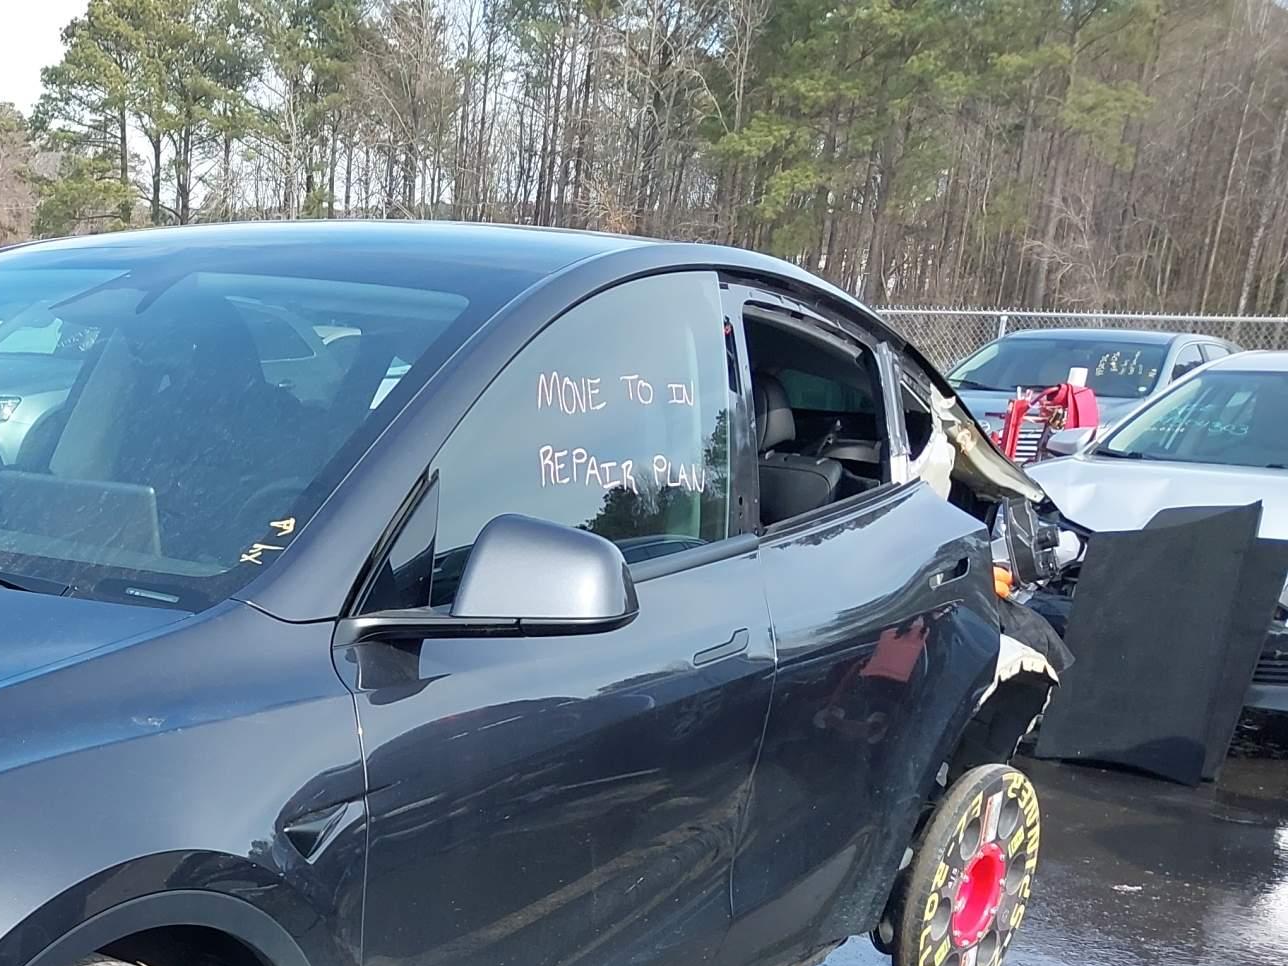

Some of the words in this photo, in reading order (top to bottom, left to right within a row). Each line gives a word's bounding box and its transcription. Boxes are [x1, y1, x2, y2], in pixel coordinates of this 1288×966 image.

[537, 371, 606, 414] MOVE
[619, 374, 653, 404] TO
[667, 379, 695, 406] IN
[538, 445, 639, 494] REPAIR
[652, 454, 705, 493] PLAN
